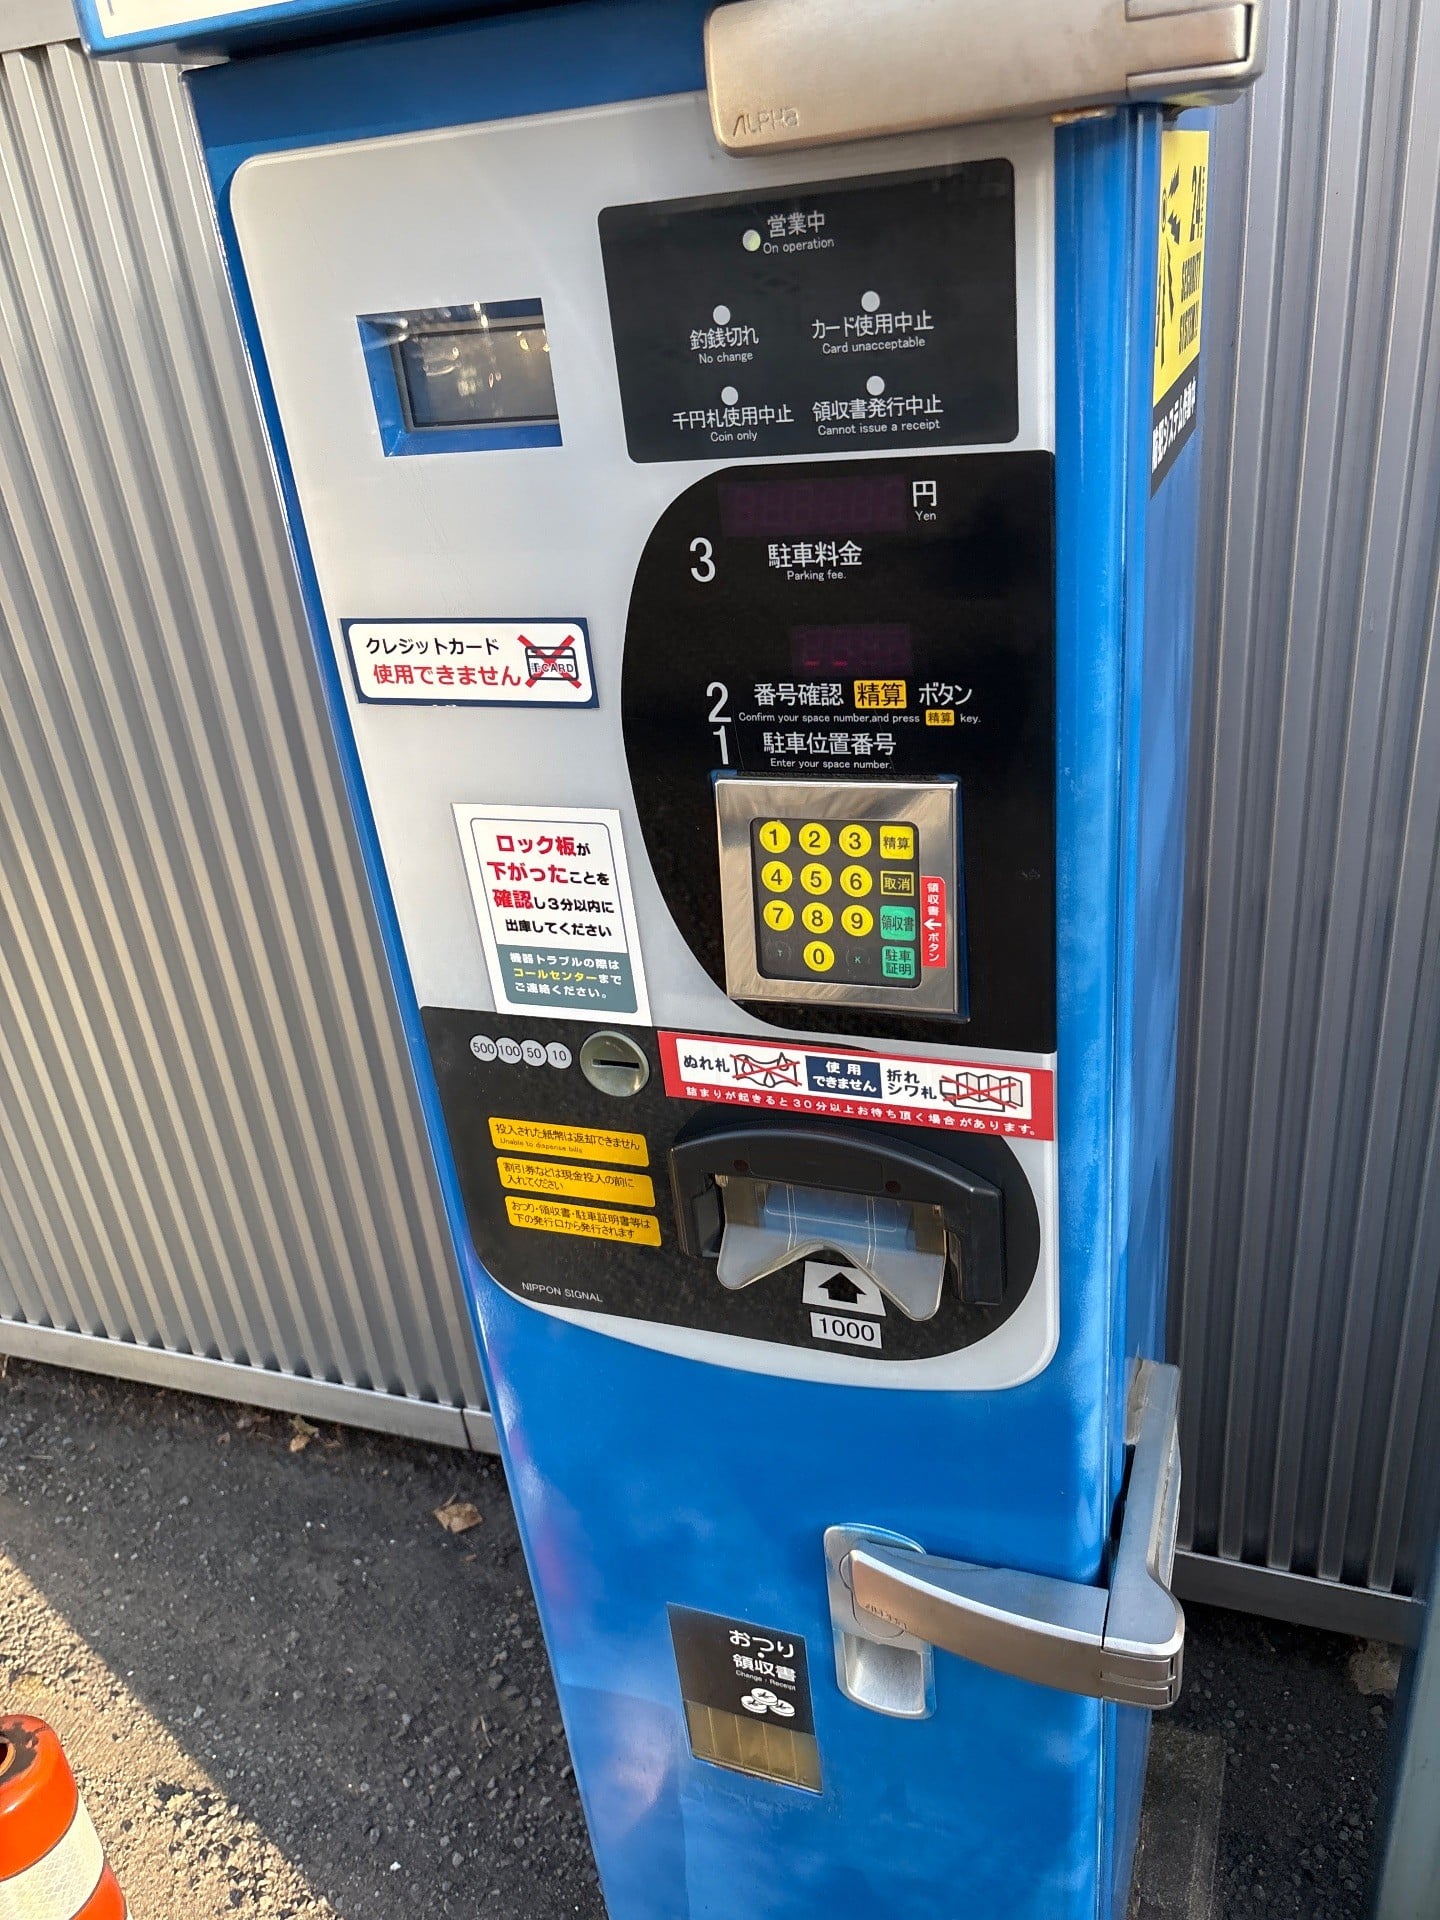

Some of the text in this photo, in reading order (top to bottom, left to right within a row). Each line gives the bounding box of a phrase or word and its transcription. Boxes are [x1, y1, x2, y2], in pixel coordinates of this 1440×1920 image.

[767, 210, 825, 239] 営業中
[763, 238, 834, 255] On operation
[811, 310, 934, 340] カード使用中止
[690, 325, 759, 351] 釣銭切れ
[822, 336, 925, 355] Card unacceptable
[699, 350, 753, 364] No change
[672, 403, 794, 430] 千円札使用中止
[812, 395, 943, 423] 領収書発行中止
[818, 419, 940, 436] Cannot issue a receipt
[710, 430, 758, 443] Coin only
[912, 481, 937, 507] 円
[915, 510, 937, 521] Yen
[689, 537, 716, 583] 3
[768, 540, 862, 569] 駐車料金
[787, 570, 847, 582] Parking fee.
[366, 637, 499, 656] クレジットカード
[373, 665, 521, 687] 使用できません
[706, 681, 732, 723] 2
[754, 682, 973, 707] 番号確認 精算 ボタン
[738, 712, 776, 723] Confirm
[778, 714, 799, 723] your
[802, 714, 830, 724] space
[892, 714, 920, 725] press
[927, 712, 953, 724] 精算
[959, 713, 982, 724] key.
[713, 725, 729, 765] 1
[763, 732, 897, 755] 駐車位置番号
[770, 758, 892, 770] Enter your space number.
[496, 835, 590, 857] ロック板が
[769, 829, 778, 846] 1
[808, 831, 821, 848] 2
[848, 832, 861, 850] 3
[883, 836, 910, 850] 精算
[487, 862, 609, 886] 下がったことを
[770, 869, 782, 885] 4
[810, 871, 821, 888] 5
[850, 873, 862, 890] 6
[884, 877, 910, 891] 取消
[493, 889, 614, 914] 確認し3分以内に
[773, 907, 784, 924] 7
[811, 910, 824, 927] 8
[851, 912, 863, 929] 9
[881, 914, 915, 932] 領収書
[505, 919, 612, 938] 出庫してください
[510, 952, 619, 971] 機器トラブルの際は
[812, 949, 825, 965] 0
[886, 950, 911, 962] 駐車
[513, 968, 622, 985] コールセンターまで
[886, 963, 912, 976] 証明
[514, 982, 607, 999] ご連絡ください。
[473, 1043, 495, 1054] 500
[498, 1045, 521, 1057] 100
[526, 1047, 542, 1060] 50
[553, 1050, 567, 1061] 10
[684, 1056, 731, 1074] ぬれ札
[813, 1076, 877, 1093] できません
[887, 1069, 920, 1084] 折れ
[887, 1082, 937, 1100] シワ札
[496, 1123, 640, 1150] 投入された紙幣は返却できません
[503, 1162, 634, 1188] 割引券などは現金投入の前に
[507, 1175, 563, 1190] 入れてください
[514, 1213, 635, 1238] 下の発行口から発行されます
[522, 1282, 603, 1302] NIPPON SIGNAL
[819, 1317, 875, 1341] 1000
[729, 1629, 794, 1658] おつり
[732, 1653, 797, 1683] 領収書
[735, 1669, 762, 1682] Change
